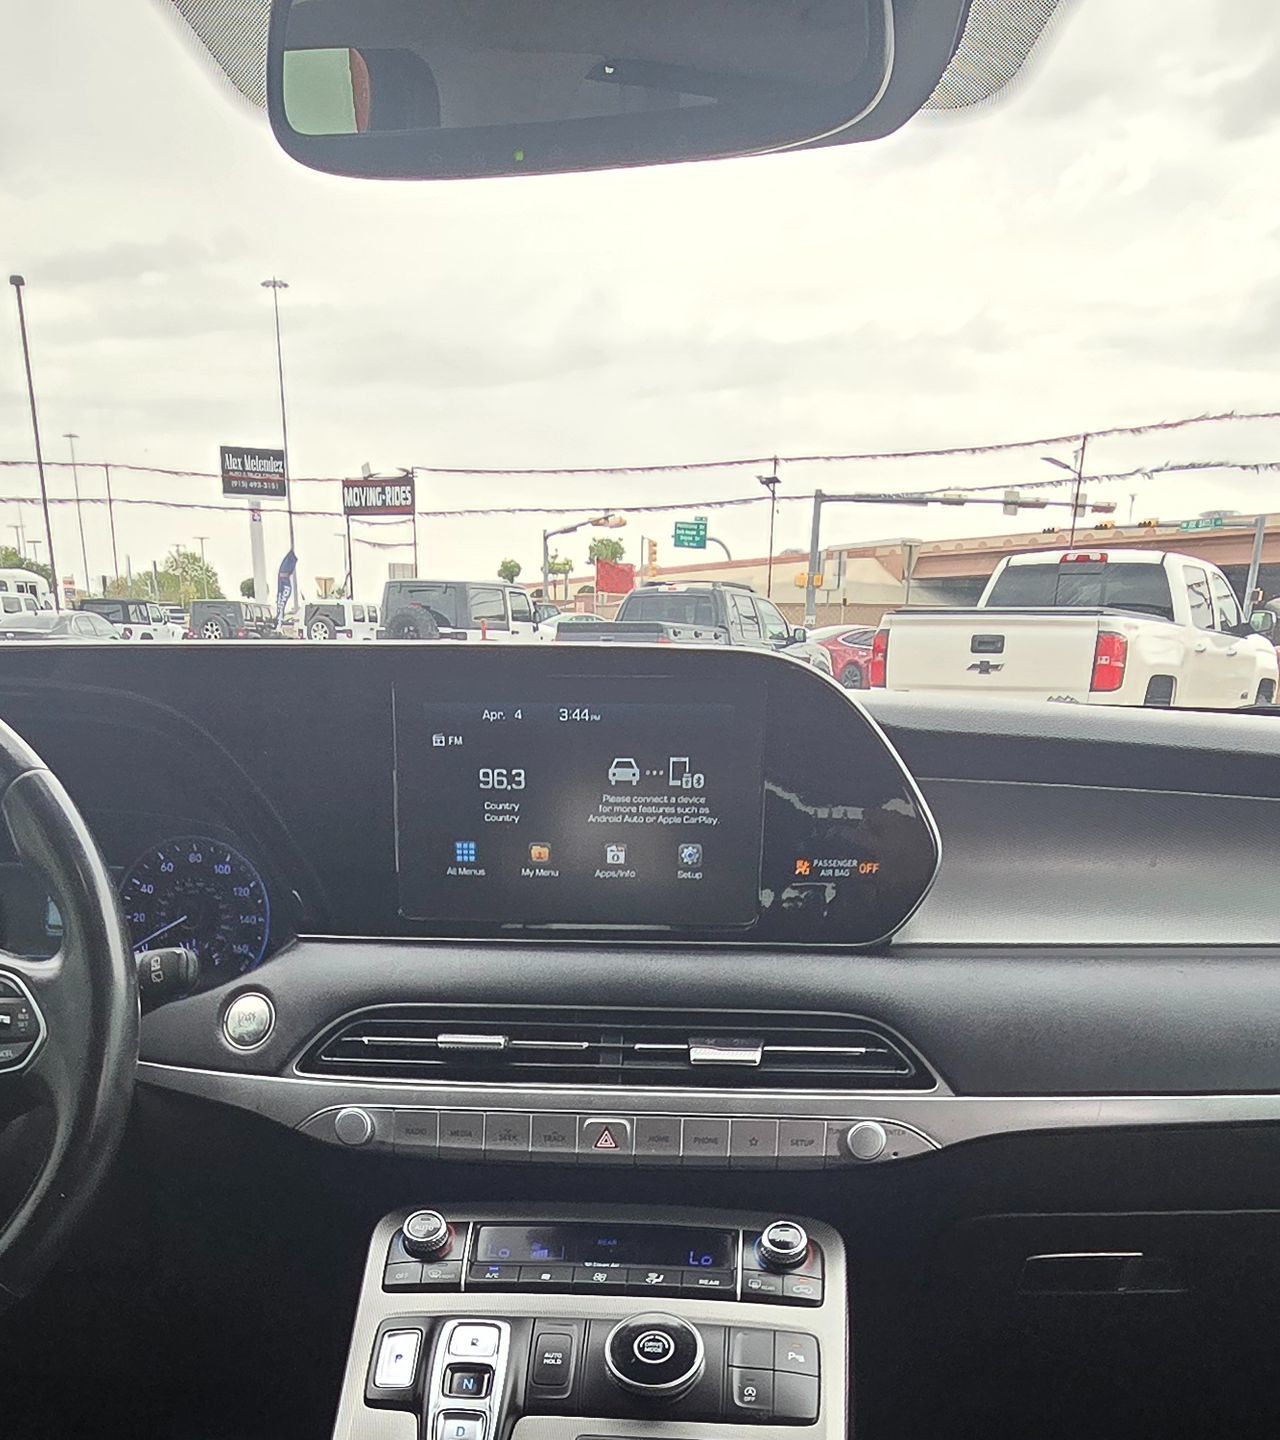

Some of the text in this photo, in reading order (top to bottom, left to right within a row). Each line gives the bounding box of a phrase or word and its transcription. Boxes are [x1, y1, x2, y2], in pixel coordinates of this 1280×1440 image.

[224, 453, 284, 474] Alex Melendez
[482, 709, 522, 722] Apr. 4
[448, 736, 463, 746] FM
[479, 768, 525, 790] 96.3
[602, 794, 631, 804] Please
[632, 795, 668, 804] connect
[677, 796, 706, 804] device
[484, 802, 520, 811] Country
[599, 804, 612, 813] for
[638, 805, 675, 814] features
[677, 805, 697, 814] such
[484, 814, 520, 824] Country
[588, 814, 622, 823] Android
[623, 815, 644, 823] Auto
[657, 815, 682, 825] Apple
[683, 815, 720, 826] CarPlay.
[188, 853, 202, 863] 80
[813, 859, 858, 867] PASSENGER
[160, 863, 174, 873] 60
[214, 864, 231, 874] 100
[446, 867, 486, 876] All Menus
[521, 868, 559, 878] My Menu
[819, 869, 850, 877] AIR BAG
[859, 863, 880, 874] OFF
[677, 870, 702, 880] Setup
[140, 884, 154, 894] 40
[233, 887, 250, 897] 120
[133, 913, 145, 923] 20
[240, 915, 257, 925] 140
[405, 1128, 427, 1136] RADIO
[450, 1129, 472, 1137] MEDIA
[543, 1134, 566, 1143] TRACK
[693, 1136, 719, 1145] PHONE
[790, 1139, 815, 1147] SETUP
[689, 1251, 712, 1266] Lo
[395, 1354, 403, 1364] P
[462, 1378, 474, 1390] N
[456, 1426, 466, 1438] D
